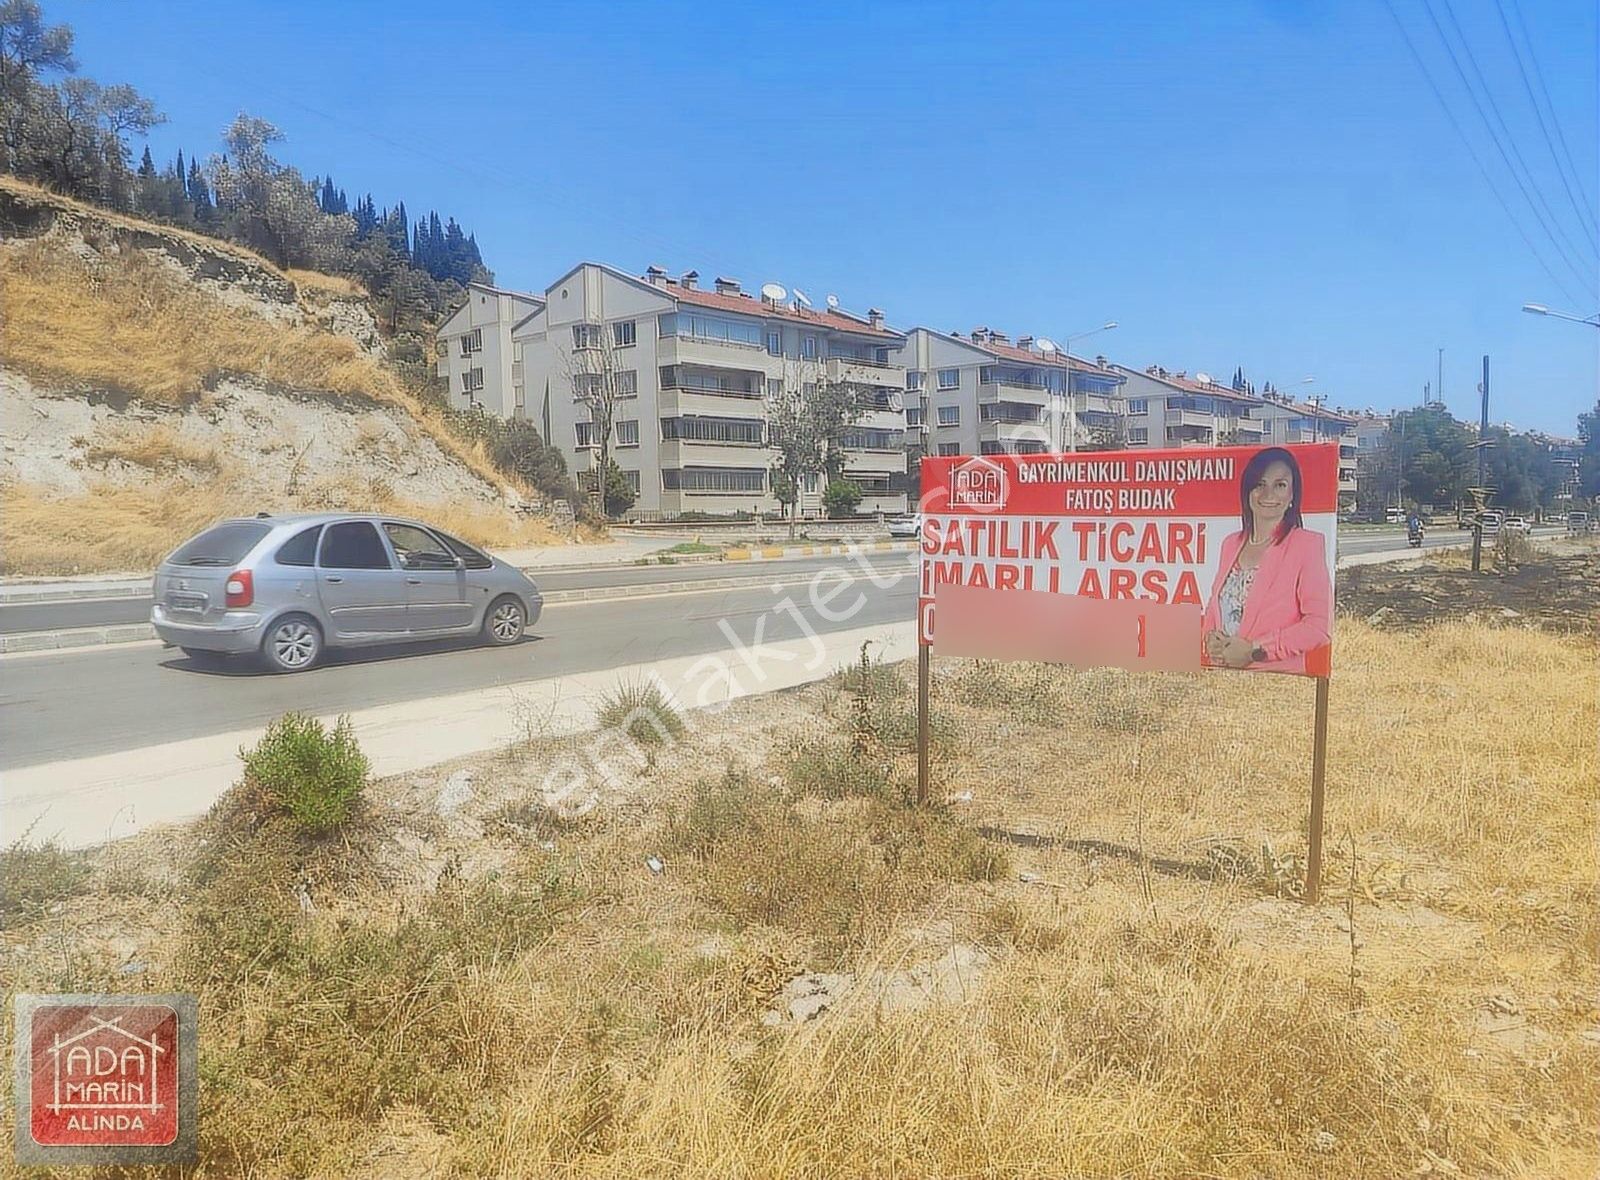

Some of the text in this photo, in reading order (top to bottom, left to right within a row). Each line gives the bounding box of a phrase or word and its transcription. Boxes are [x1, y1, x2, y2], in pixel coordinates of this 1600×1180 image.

[957, 470, 997, 488] ADA
[1018, 458, 1234, 485] GAYRİMENKUL DANIŞMANI
[1066, 488, 1176, 514] FATOŞ BUDAK
[922, 518, 1060, 560] SATILIK
[1078, 567, 1203, 606] ARSA
